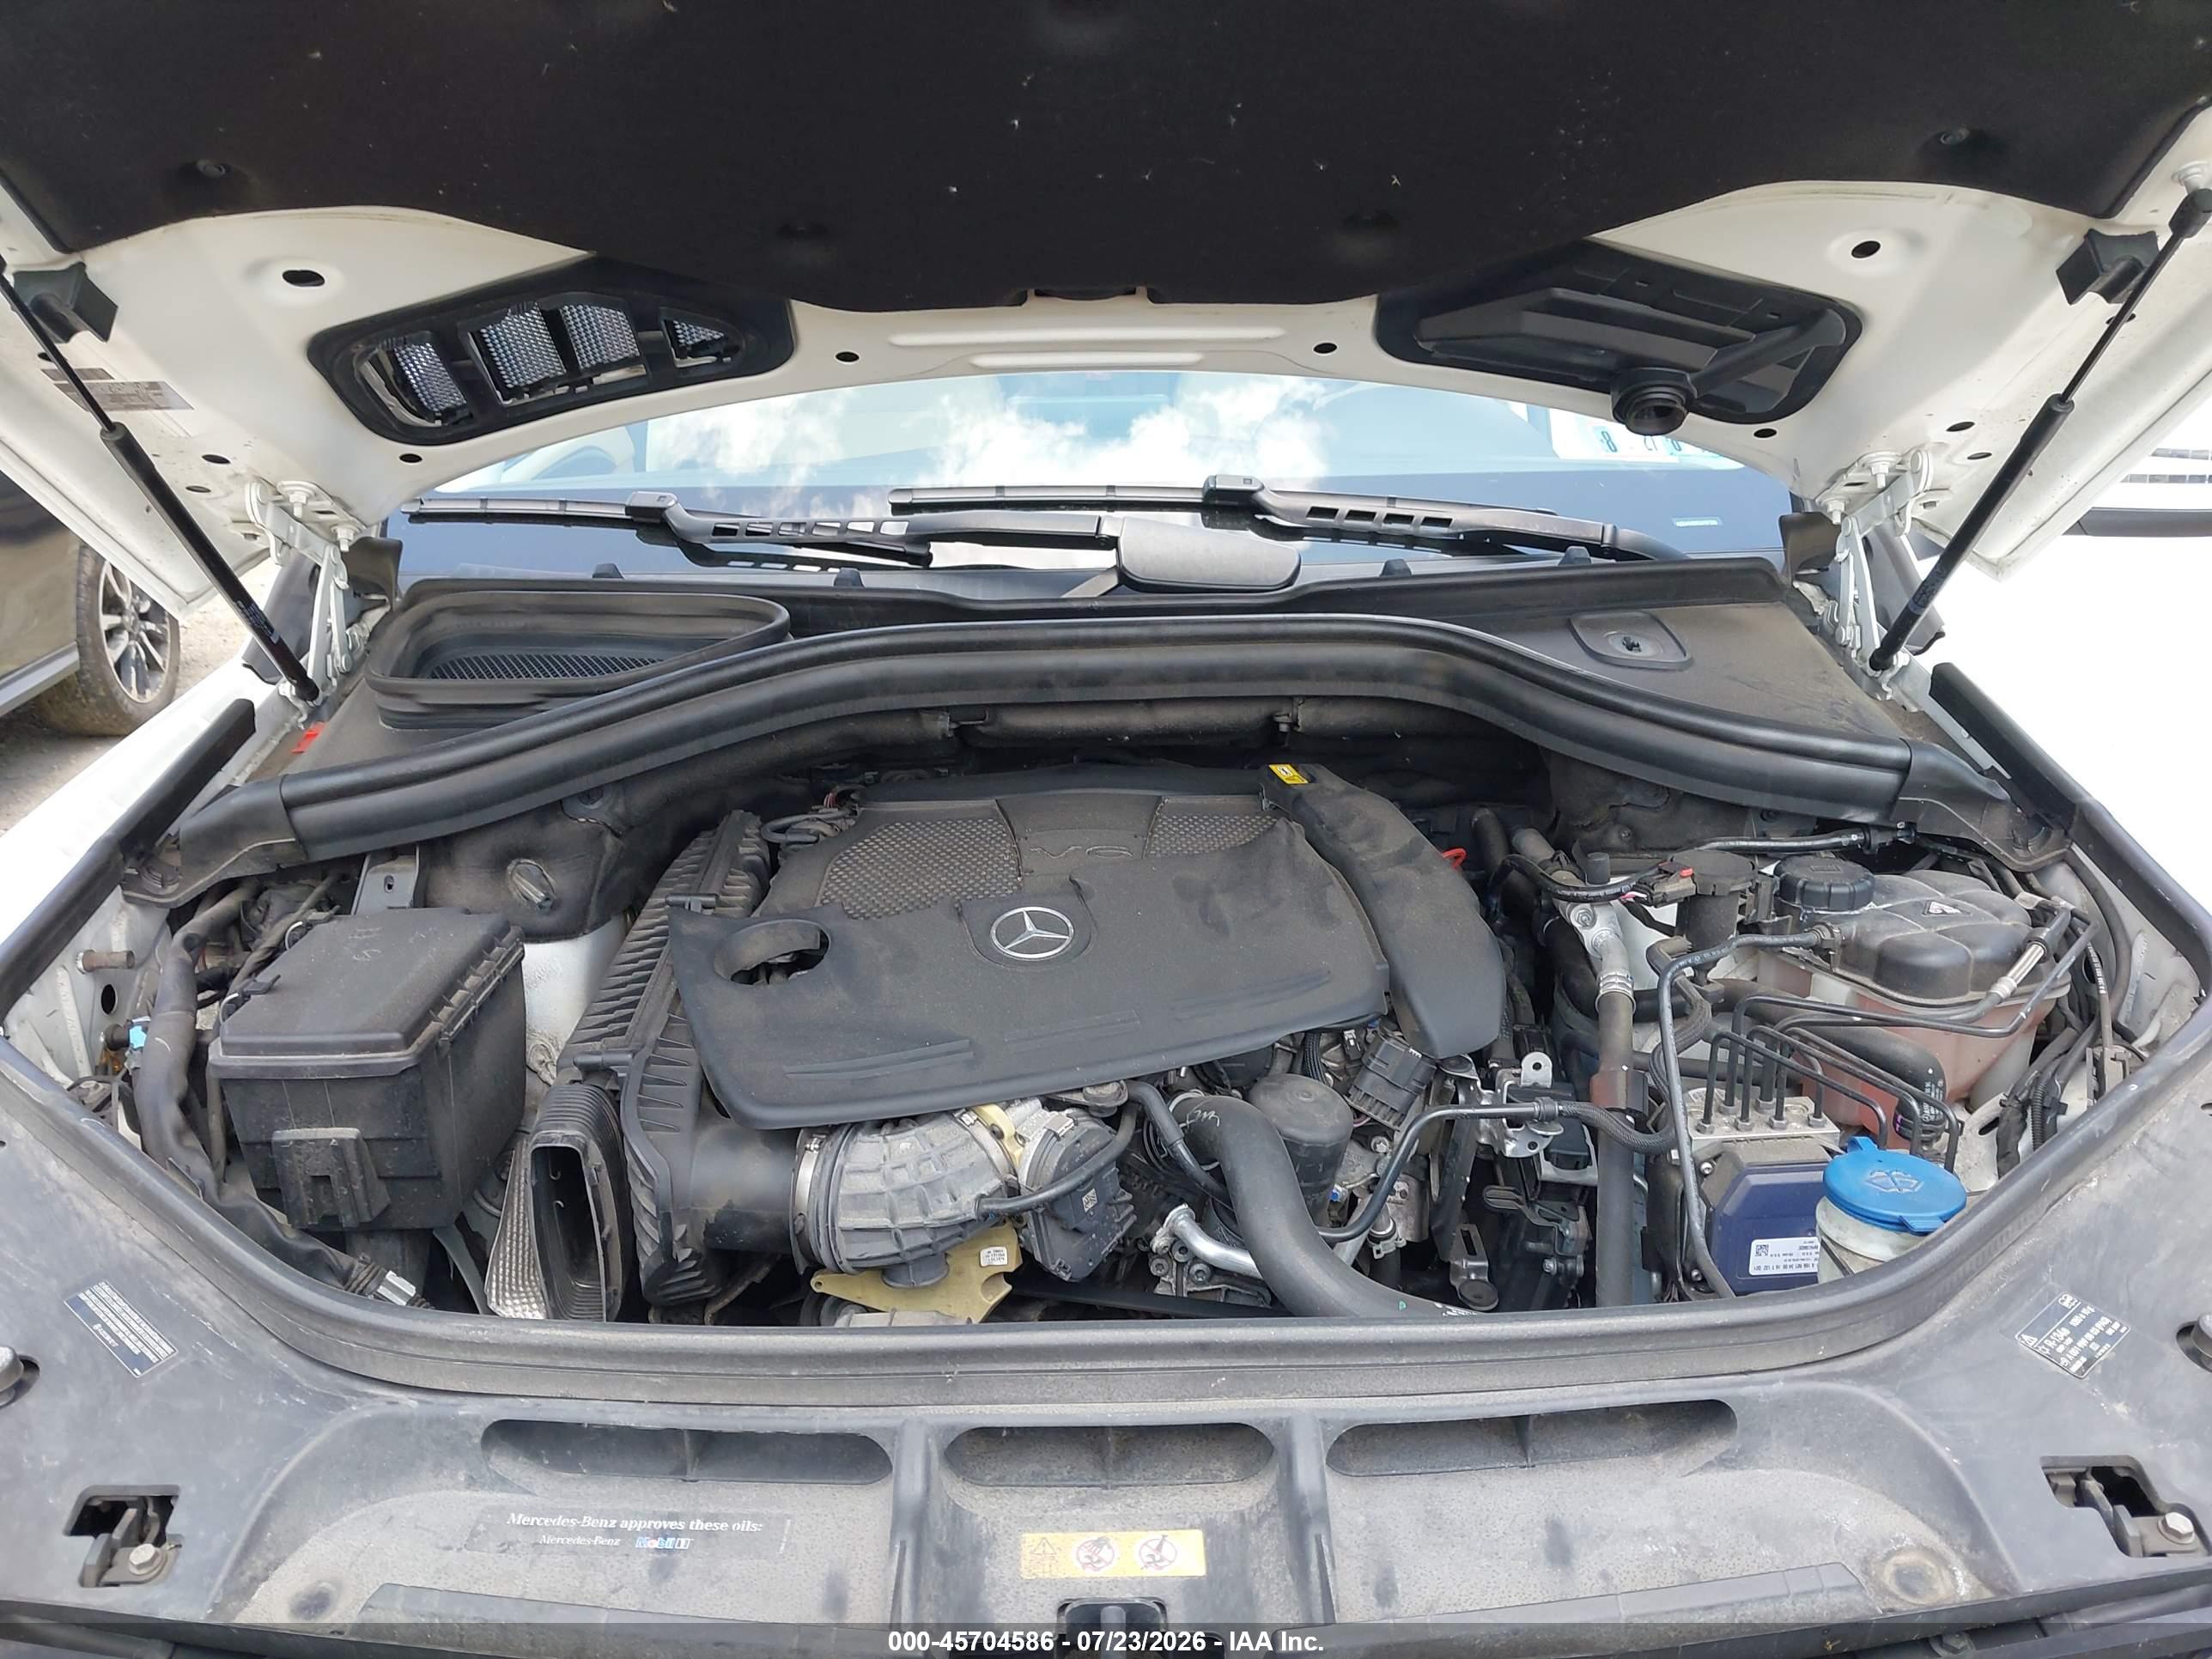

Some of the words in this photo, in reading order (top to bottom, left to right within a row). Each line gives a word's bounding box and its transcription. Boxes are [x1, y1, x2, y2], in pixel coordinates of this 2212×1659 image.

[507, 1513, 617, 1528] Mercedes-Benz
[619, 1518, 685, 1531] approves
[689, 1518, 728, 1531] these
[732, 1520, 763, 1532] oils:
[539, 1534, 622, 1547] Mercedes-Benz
